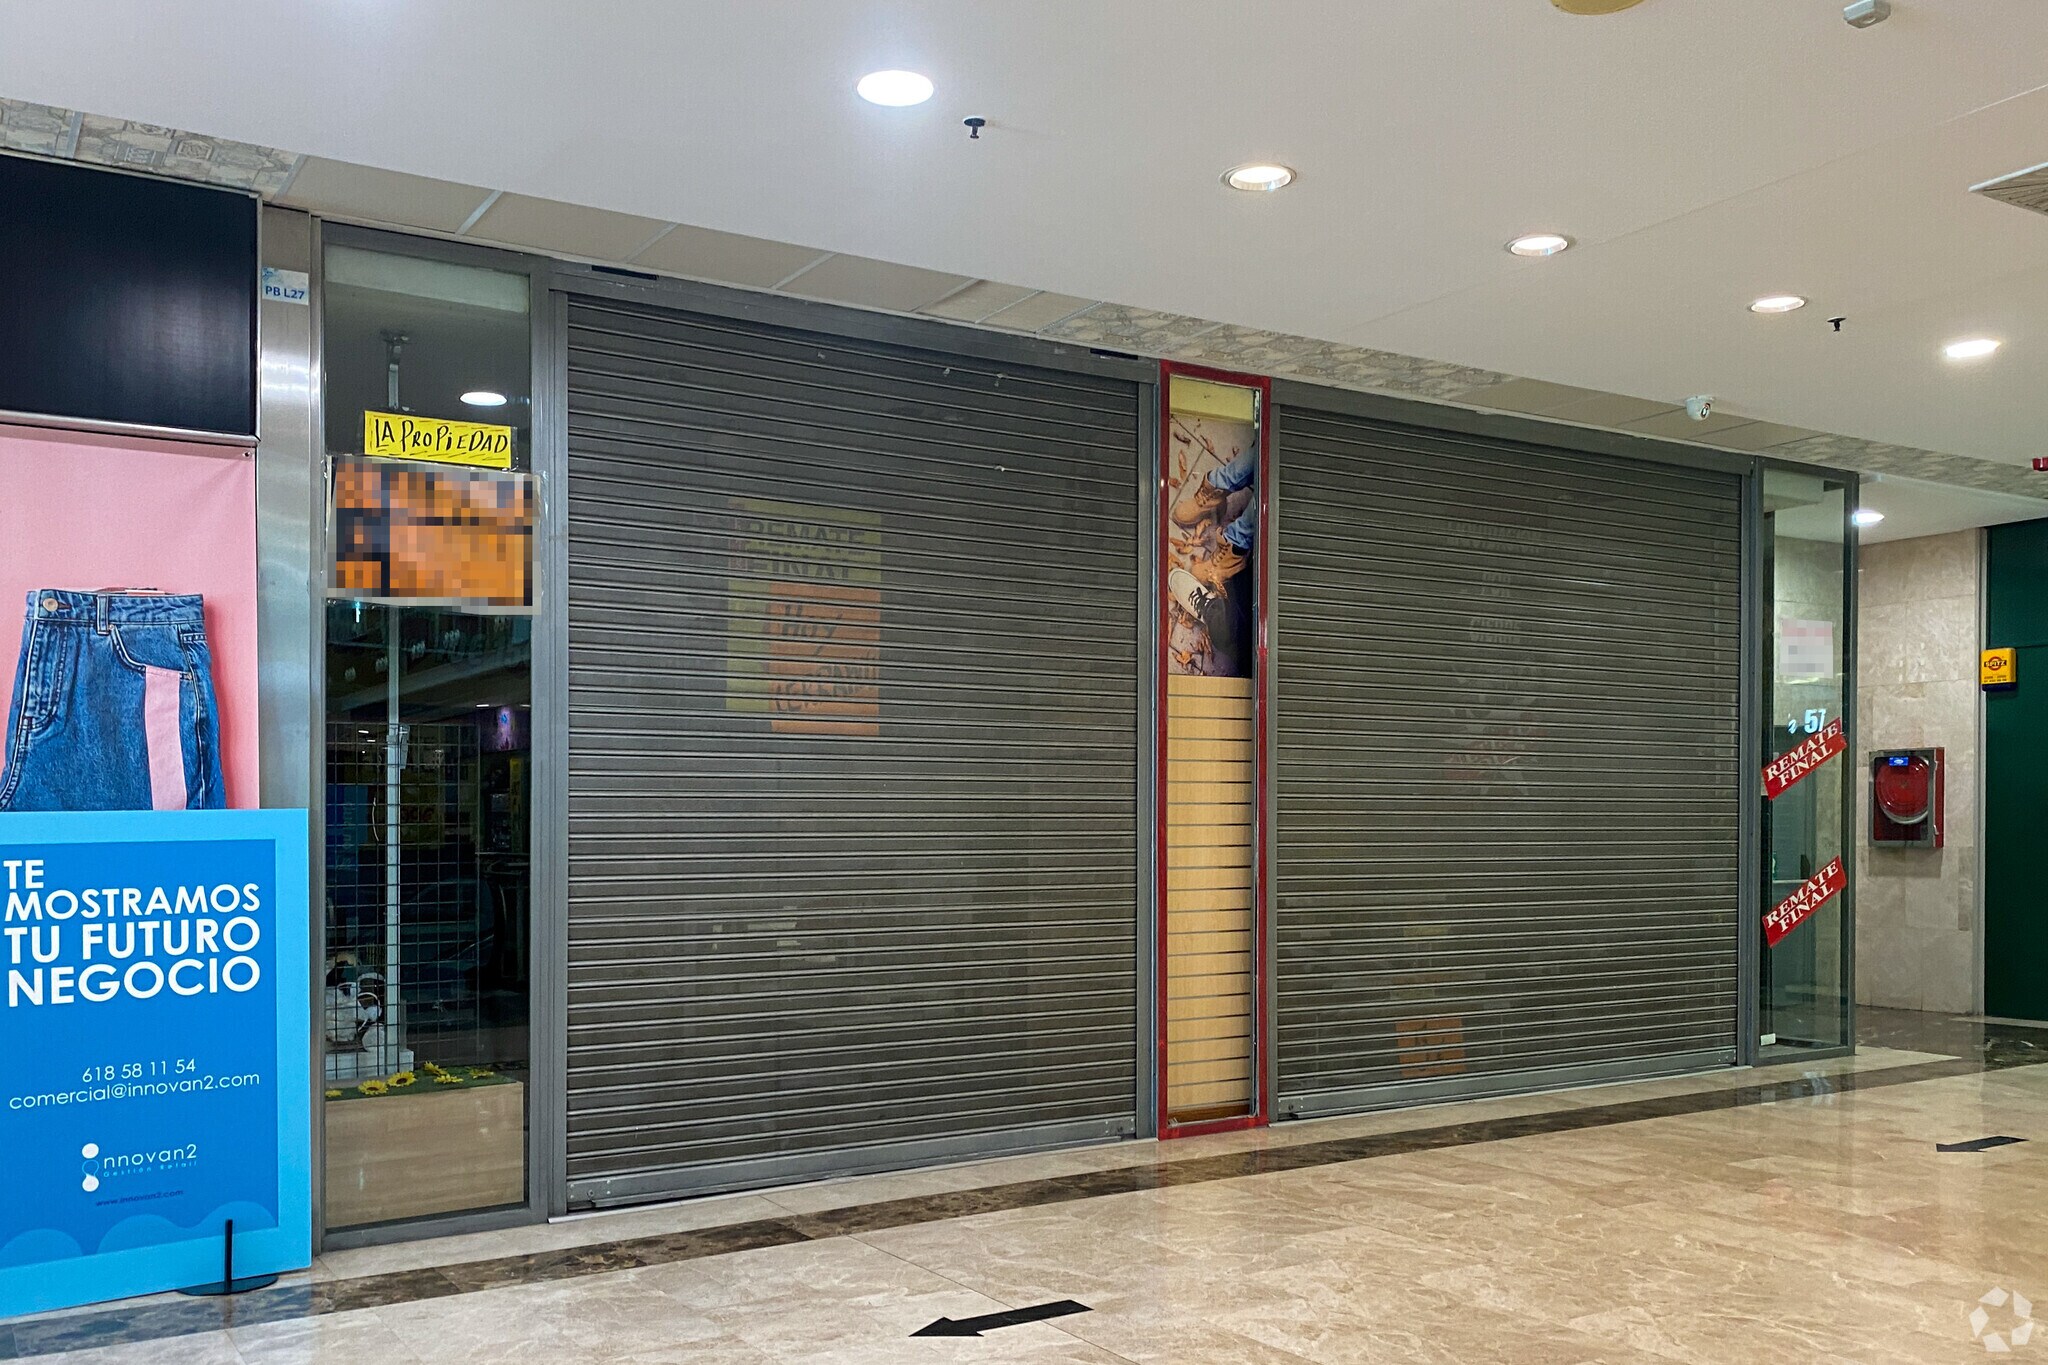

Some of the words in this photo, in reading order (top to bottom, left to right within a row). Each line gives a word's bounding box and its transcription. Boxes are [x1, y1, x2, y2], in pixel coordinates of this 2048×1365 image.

[265, 285, 281, 297] PB
[283, 288, 305, 300] L27
[375, 418, 395, 448] LA
[1766, 723, 1838, 782] REMATE
[1779, 743, 1833, 788] FINAL
[3, 859, 44, 890] TE
[1766, 861, 1839, 929] REMATE
[4, 883, 261, 922] MOSTRAMOS
[1779, 882, 1834, 933] FINAL
[4, 925, 60, 964] TU
[82, 916, 261, 960] FUTURO
[8, 955, 261, 1008] NEGOCIO
[9, 1073, 260, 1110] comercial@innovan2.com
[82, 1065, 115, 1083] 618
[121, 1063, 143, 1079] 58
[150, 1060, 167, 1076] 11
[175, 1058, 196, 1074] 54
